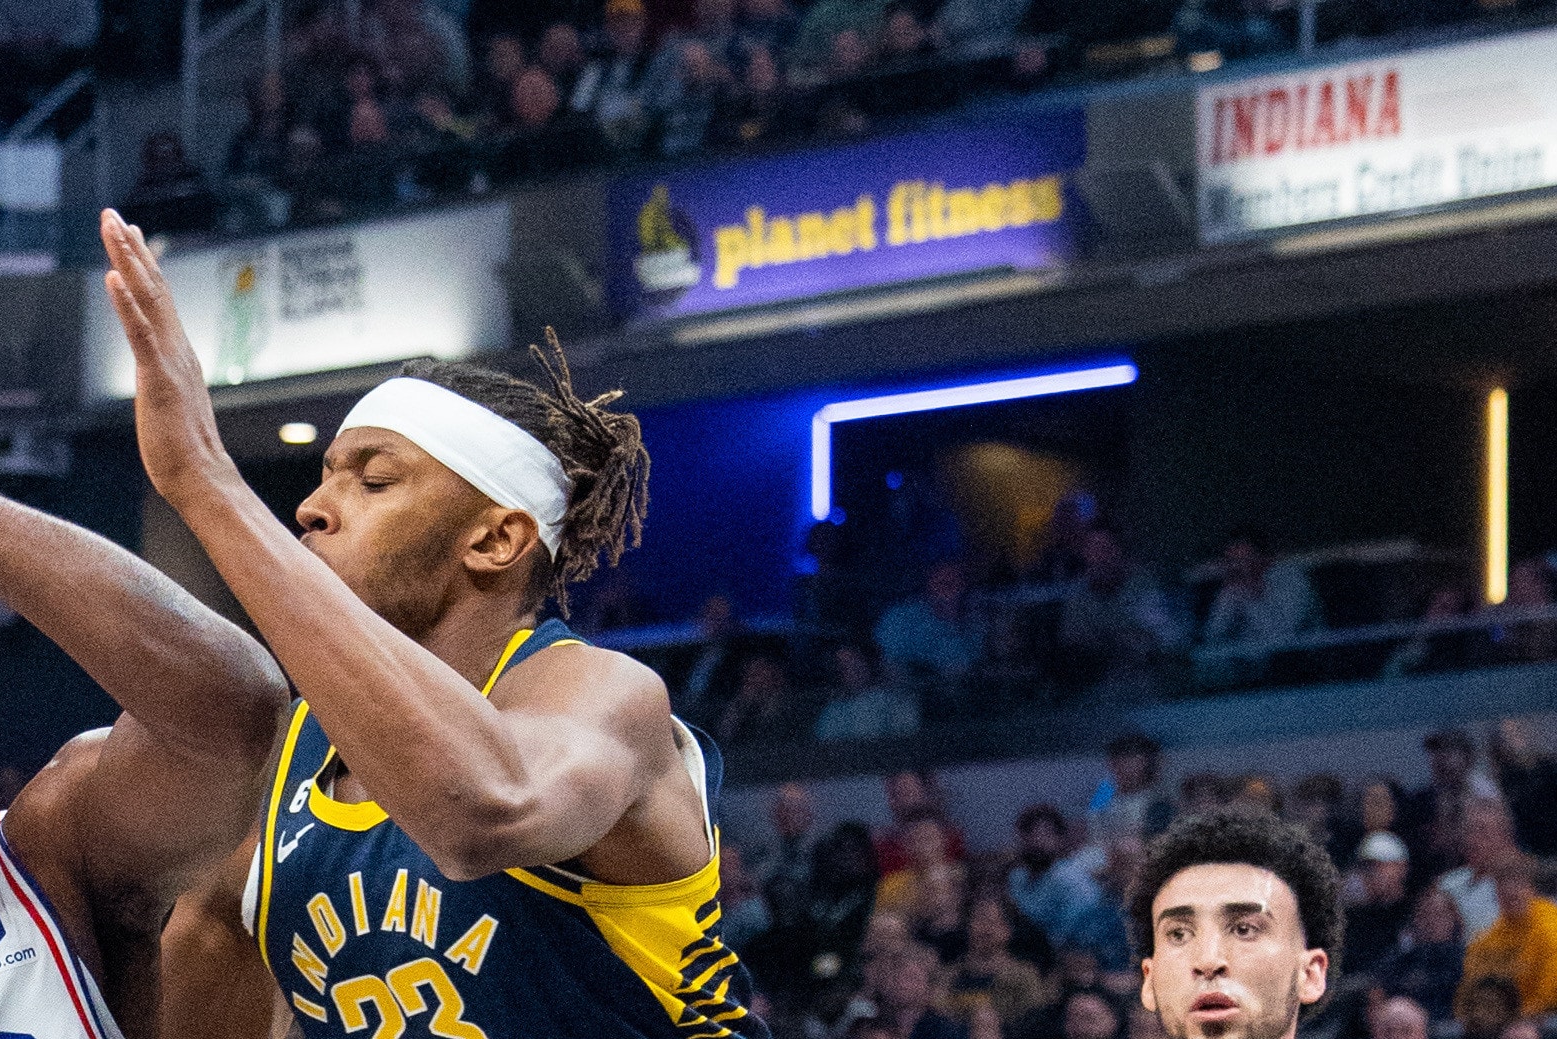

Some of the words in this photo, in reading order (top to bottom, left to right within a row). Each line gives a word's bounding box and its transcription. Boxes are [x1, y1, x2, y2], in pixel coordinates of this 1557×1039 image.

[1210, 68, 1401, 166] INDIANA
[713, 195, 876, 289] planet
[886, 176, 1063, 246] fitness
[288, 778, 314, 813] 6
[291, 868, 499, 1022] INDIANA
